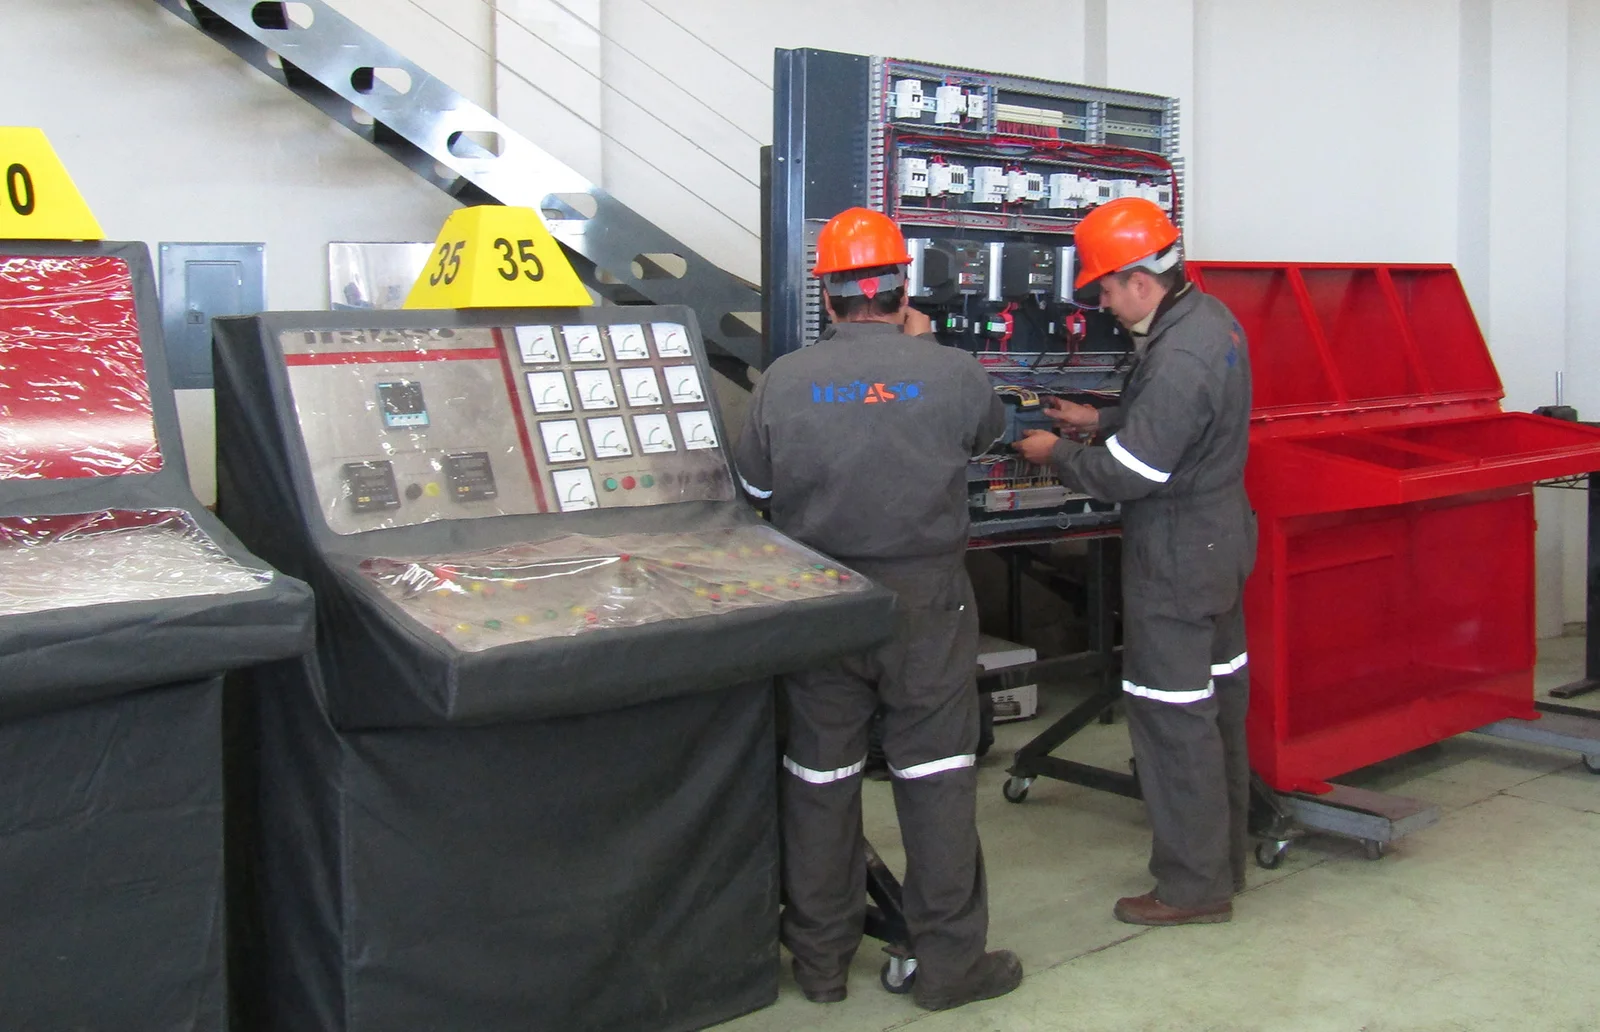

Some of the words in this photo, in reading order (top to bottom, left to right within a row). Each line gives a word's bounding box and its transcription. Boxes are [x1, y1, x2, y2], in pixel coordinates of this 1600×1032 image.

[0, 163, 35, 216] 0
[429, 240, 466, 287] 35
[494, 237, 545, 282] 35
